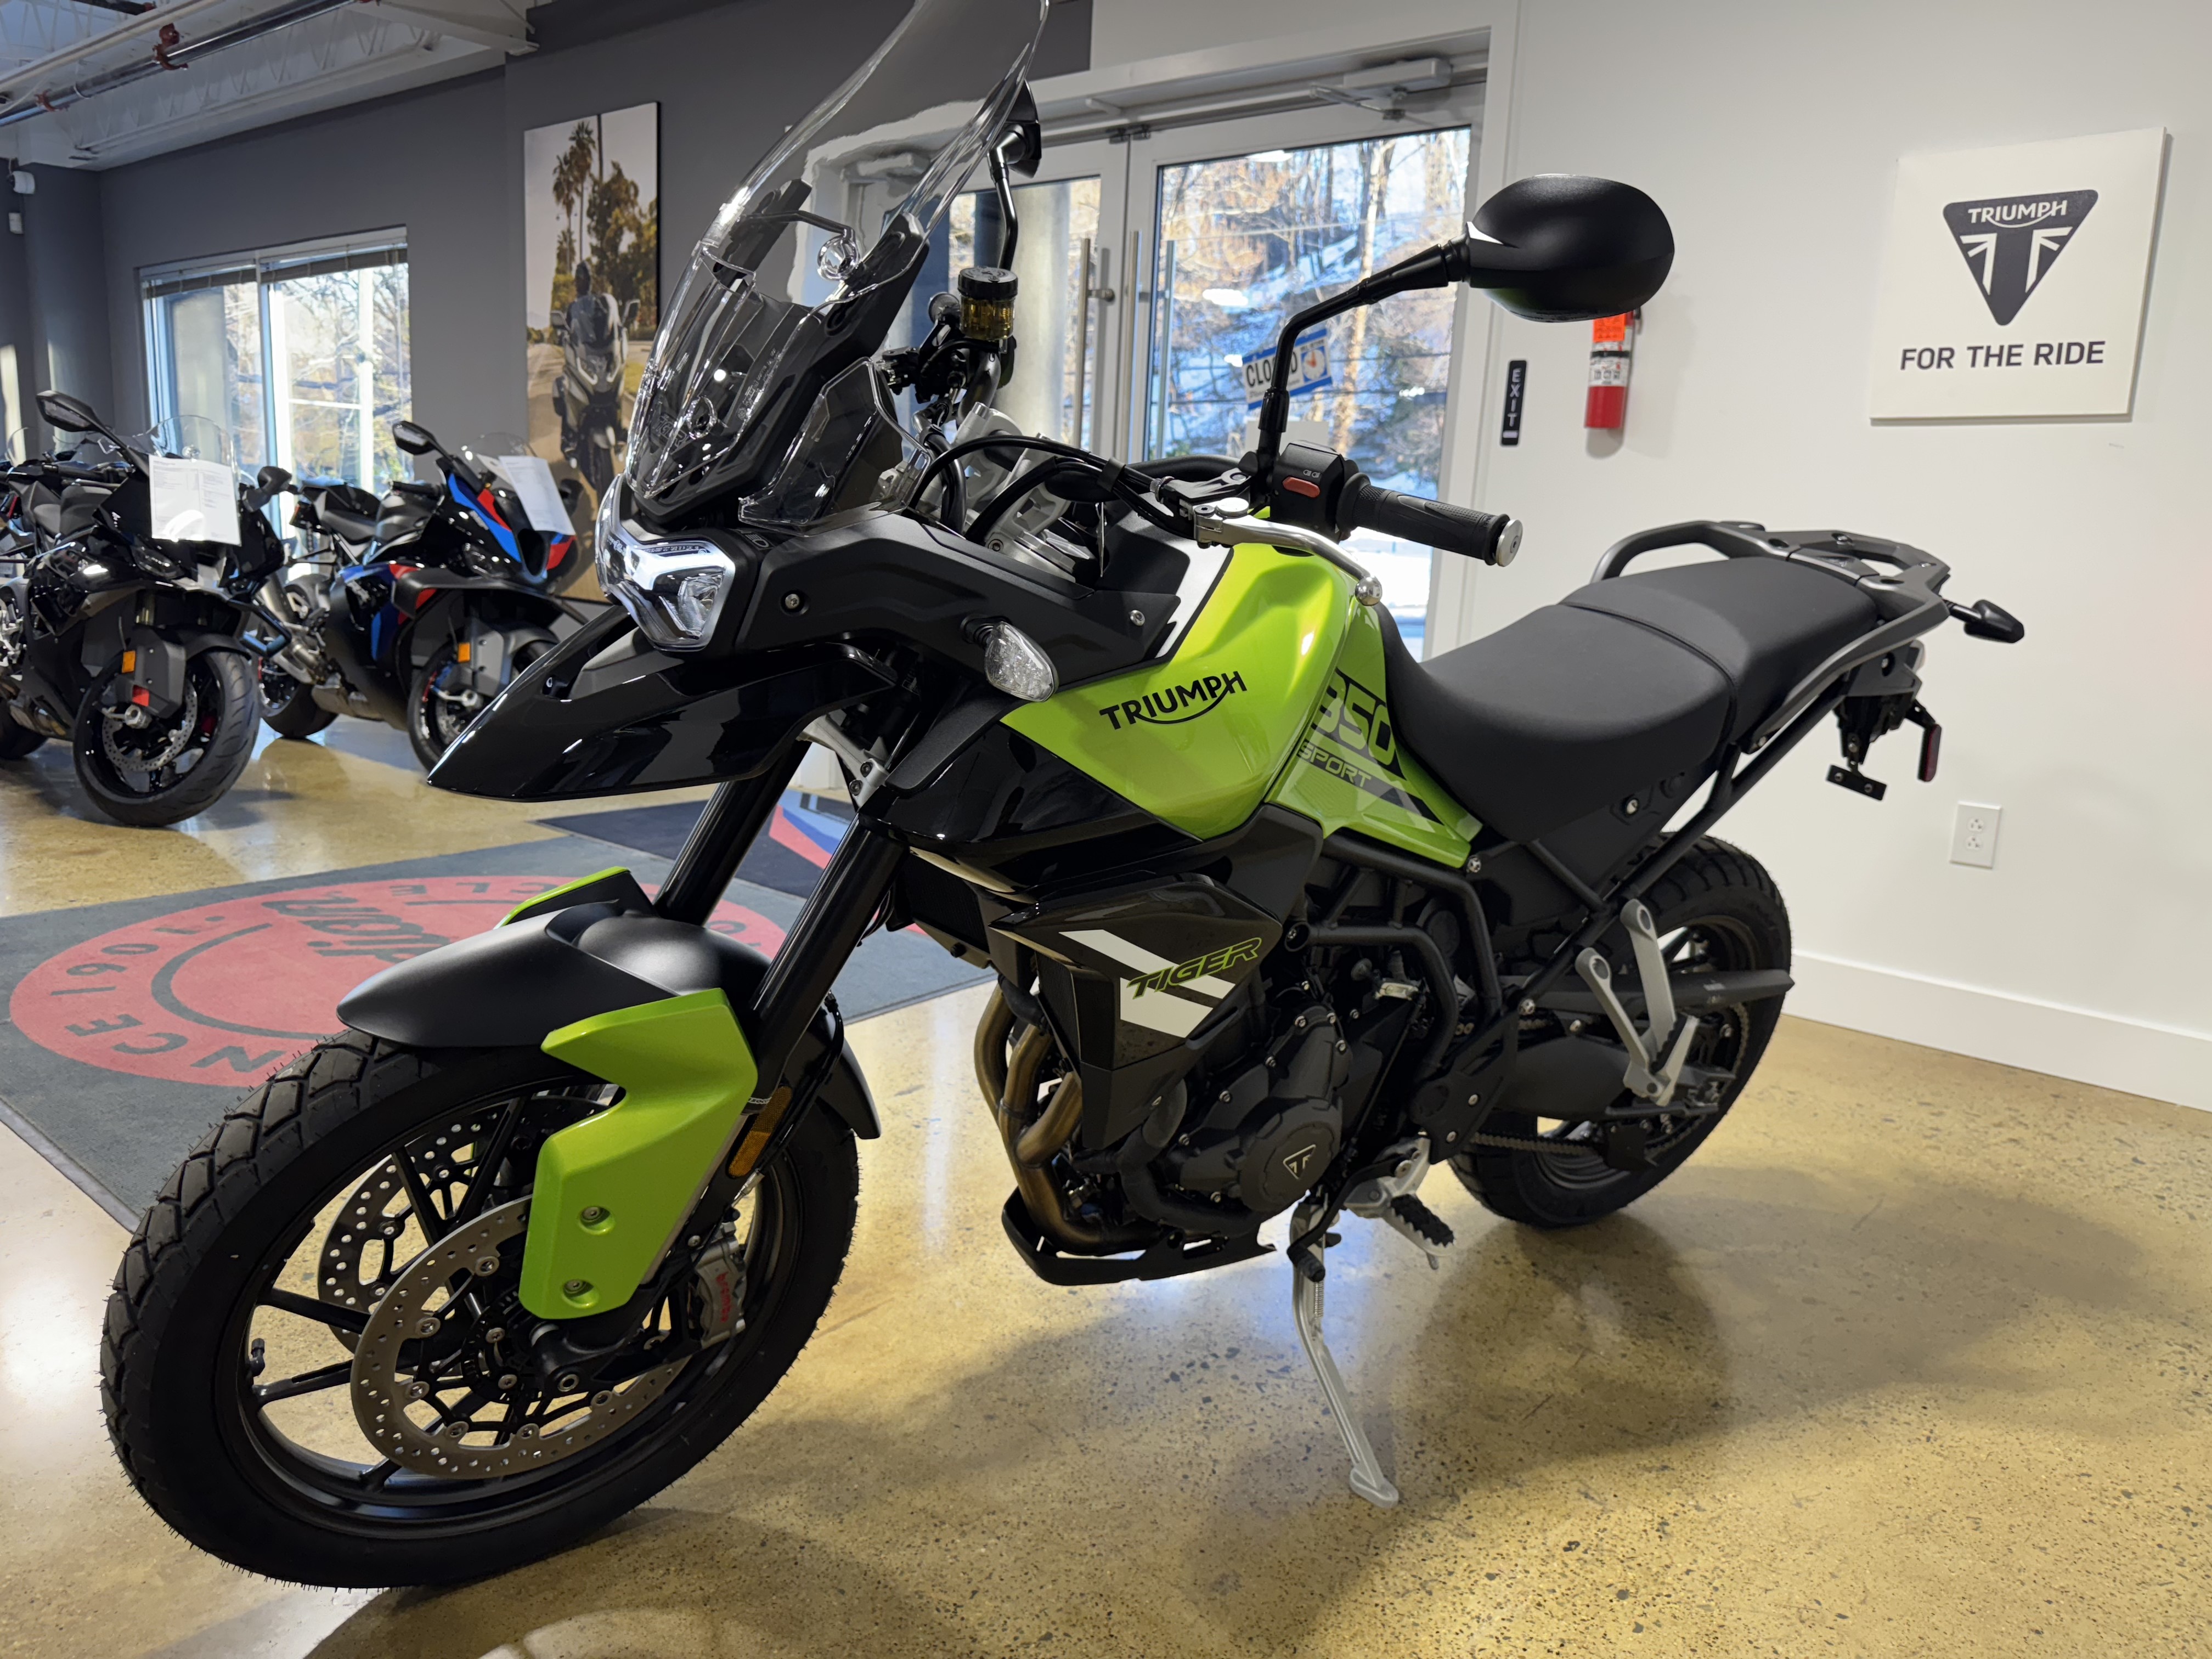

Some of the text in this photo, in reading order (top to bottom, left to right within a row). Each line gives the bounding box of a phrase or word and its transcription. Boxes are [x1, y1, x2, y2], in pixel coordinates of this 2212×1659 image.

[1968, 200, 2068, 228] TRIUMPH
[1246, 351, 1299, 387] CLOD
[1900, 341, 2106, 371] FOR THE RIDE
[1507, 368, 1521, 427] EXIT
[1099, 671, 1247, 730] TRIUMPH
[1298, 742, 1372, 788] SPORT
[1126, 937, 1262, 1000] TIGER
